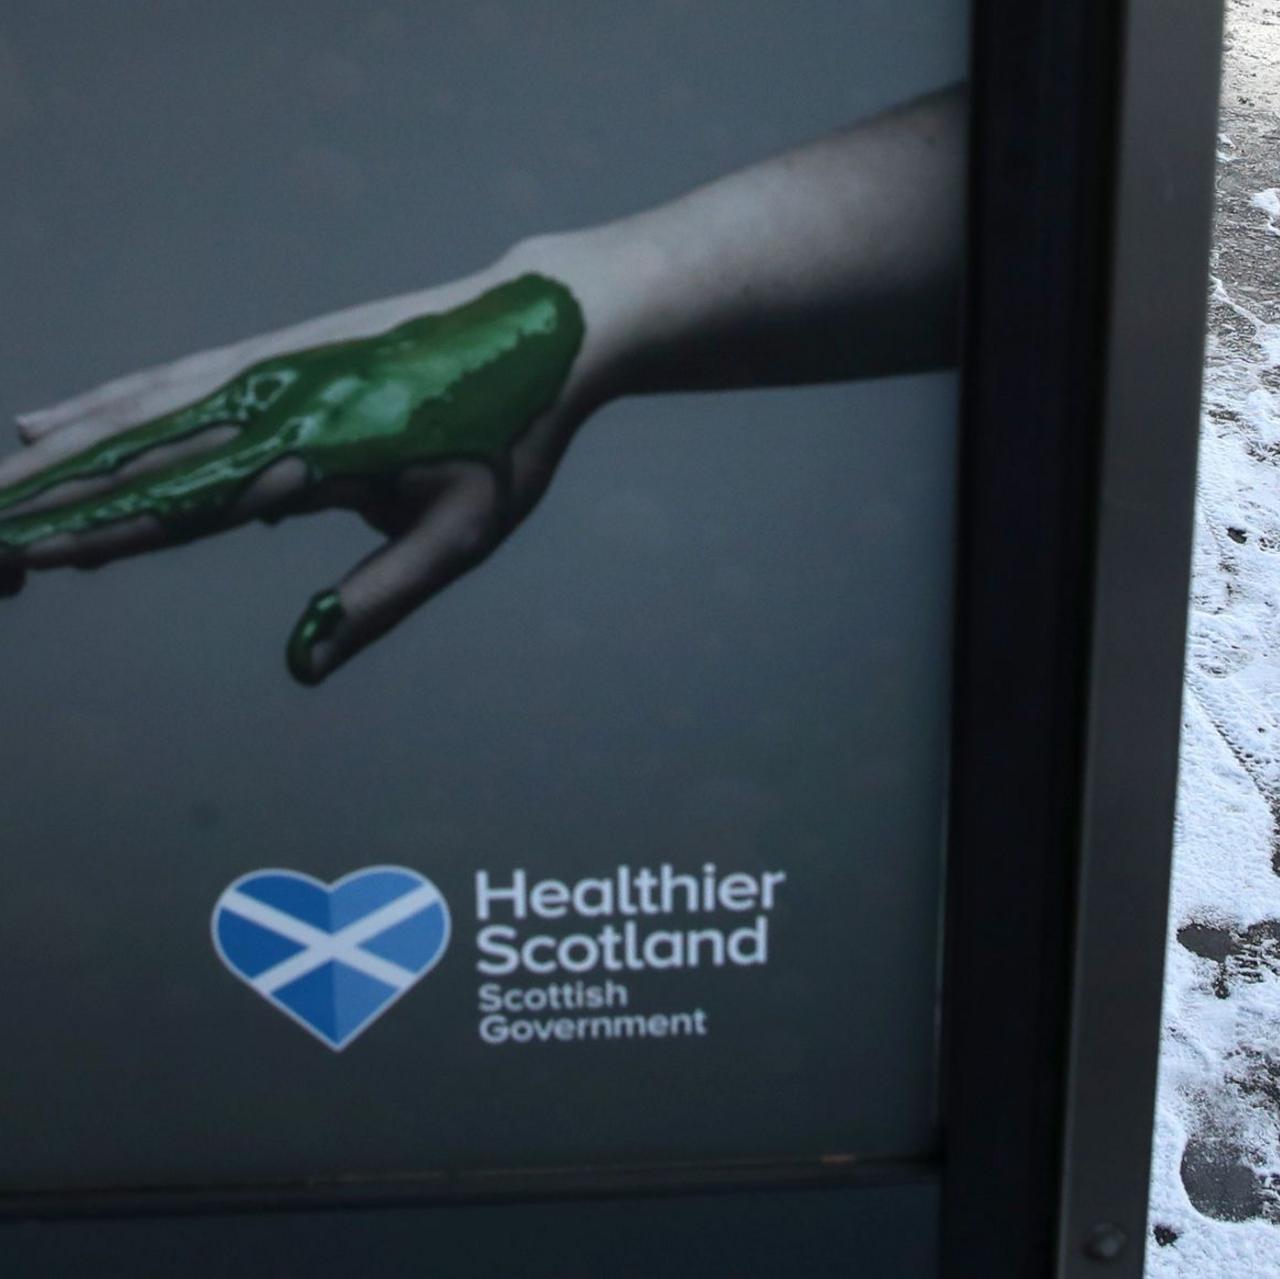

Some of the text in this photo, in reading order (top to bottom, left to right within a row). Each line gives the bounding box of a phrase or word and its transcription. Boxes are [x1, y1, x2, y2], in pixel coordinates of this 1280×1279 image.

[475, 862, 787, 920] Healthier
[475, 915, 768, 975] Scotland
[478, 980, 628, 1012] Scottish
[479, 1009, 707, 1044] Government
